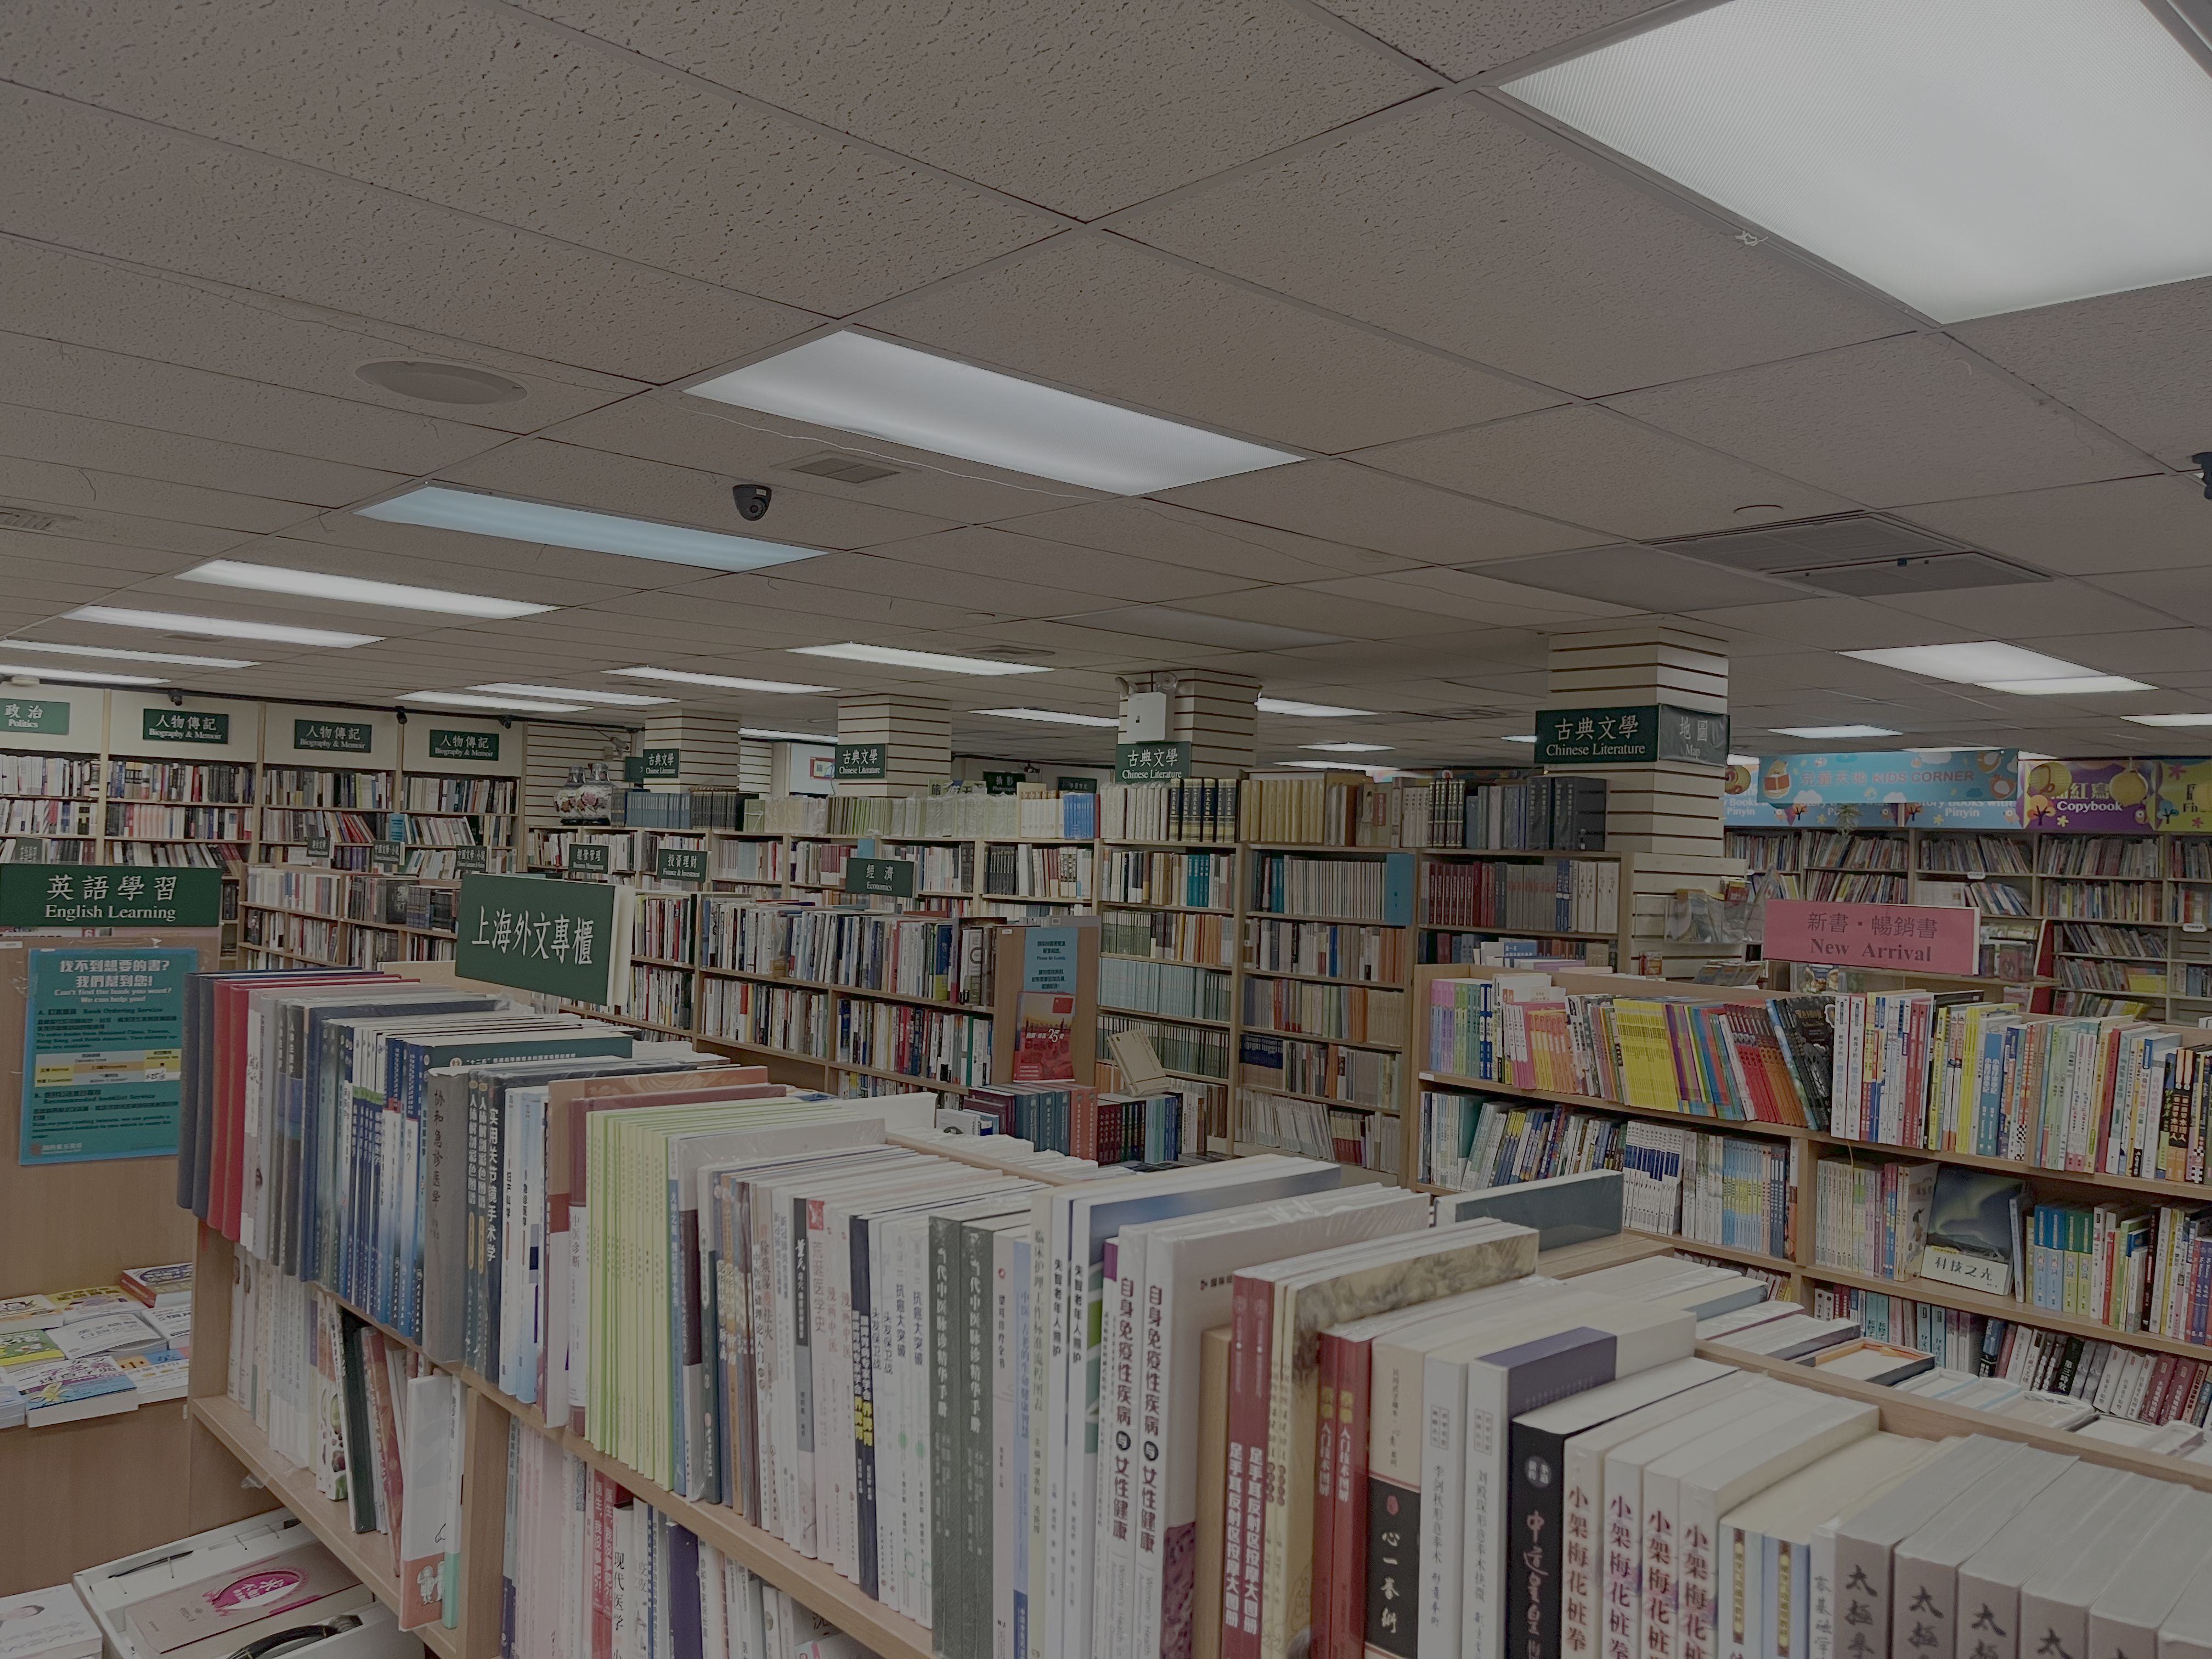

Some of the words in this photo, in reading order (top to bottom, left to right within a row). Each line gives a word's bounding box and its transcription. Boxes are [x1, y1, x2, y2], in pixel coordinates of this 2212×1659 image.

[5, 703, 43, 720] 政治
[8, 719, 38, 729] Politics
[155, 715, 217, 731] 人物傳記
[1554, 714, 1639, 742] 古典文學
[1679, 715, 1708, 742] 地圖
[149, 727, 185, 740] Biography
[194, 731, 222, 741] Memoir
[306, 725, 360, 741] 人物傳記
[441, 735, 489, 749] 人物傳記
[300, 737, 331, 748] Biography
[341, 740, 365, 750] Memoir
[435, 747, 461, 758] Biography
[471, 749, 494, 758] Memoir
[1546, 743, 1589, 757] Chinese
[1593, 743, 1645, 756] Literature
[1685, 744, 1700, 758] Map
[648, 753, 674, 766] 古典文學
[843, 749, 878, 765] 古典文學
[1126, 748, 1179, 768] 古典文學
[1122, 769, 1149, 780] Chinese
[1150, 769, 1182, 780] Literature
[1800, 770, 1867, 787] 兒童天地
[1872, 771, 1907, 784] KIDS
[1911, 770, 1975, 783] CORNER
[1726, 807, 1756, 817] Pinyin
[1945, 808, 1980, 818] Pinyin
[2057, 800, 2123, 813] Copybook
[866, 864, 894, 882] 經濟
[47, 876, 178, 900] 英語學習
[867, 882, 893, 891] Economics
[45, 905, 103, 922] English
[108, 905, 176, 922] Learning
[471, 906, 595, 964] 上海外文專櫃
[1810, 938, 1849, 957] New
[1862, 941, 1932, 962] Arrival
[486, 1108, 499, 1262] 实用关节镜手术学
[1934, 1256, 1993, 1282] 科技之光
[812, 1241, 827, 1333] 荒诞医学史
[1053, 1259, 1062, 1357] 失智老年人照护
[1073, 1265, 1083, 1363] 失智老年人照护
[936, 1247, 948, 1418] 当代中医脉诊精华手册
[968, 1260, 981, 1434] 当代中医脉诊精华手册
[1113, 1278, 1133, 1542] 自身免疫性疾病与女性健康
[1140, 1285, 1163, 1555] 自身免疫性疾病与女性健康
[1225, 1442, 1243, 1628] 足手耳反射区按摩大图册
[1244, 1447, 1263, 1635] 足手耳反射区按摩大图册
[1566, 1485, 1589, 1652] 小架梅花桩拳
[613, 1551, 625, 1631] 现代医学
[1648, 1510, 1671, 1659] 小架梅花桩
[1907, 1585, 1945, 1659] 太極
